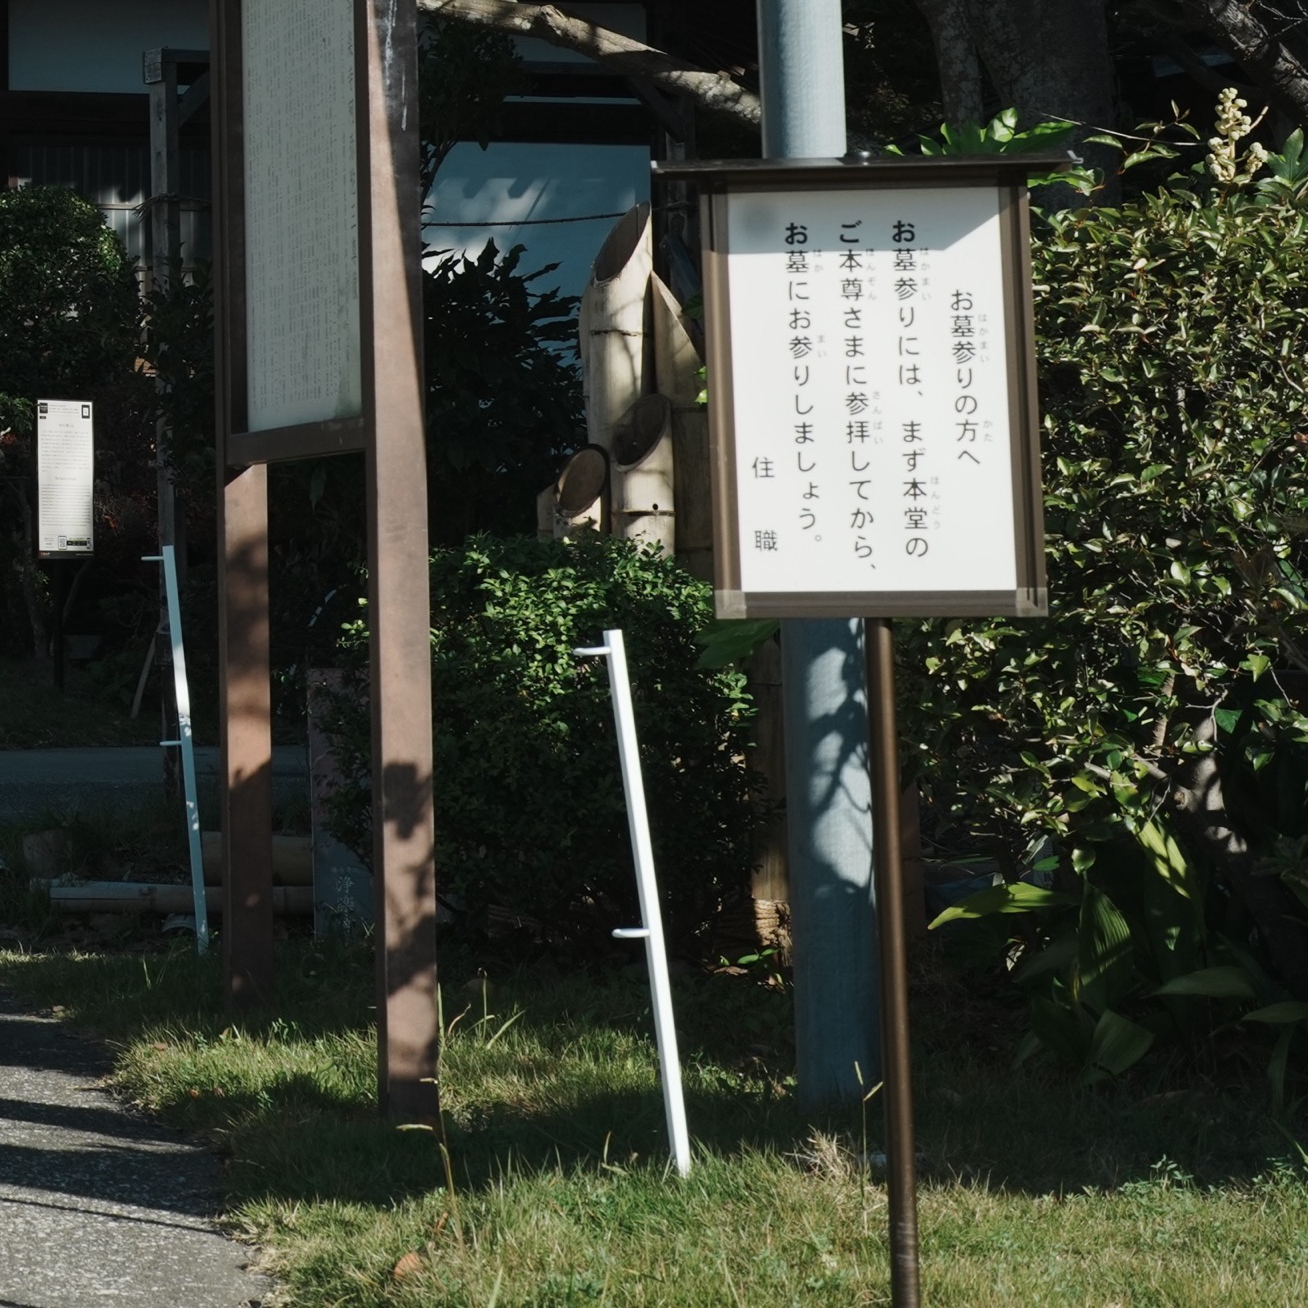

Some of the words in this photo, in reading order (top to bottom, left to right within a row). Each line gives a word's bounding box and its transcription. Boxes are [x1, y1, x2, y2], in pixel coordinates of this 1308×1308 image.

[785, 221, 822, 543] お墓にお参りしましょう。
[839, 220, 876, 571] ご本尊さまに参拝してから、
[892, 220, 929, 558] お墓参りには、まず本堂の
[950, 289, 981, 466] お墓参りの方へ
